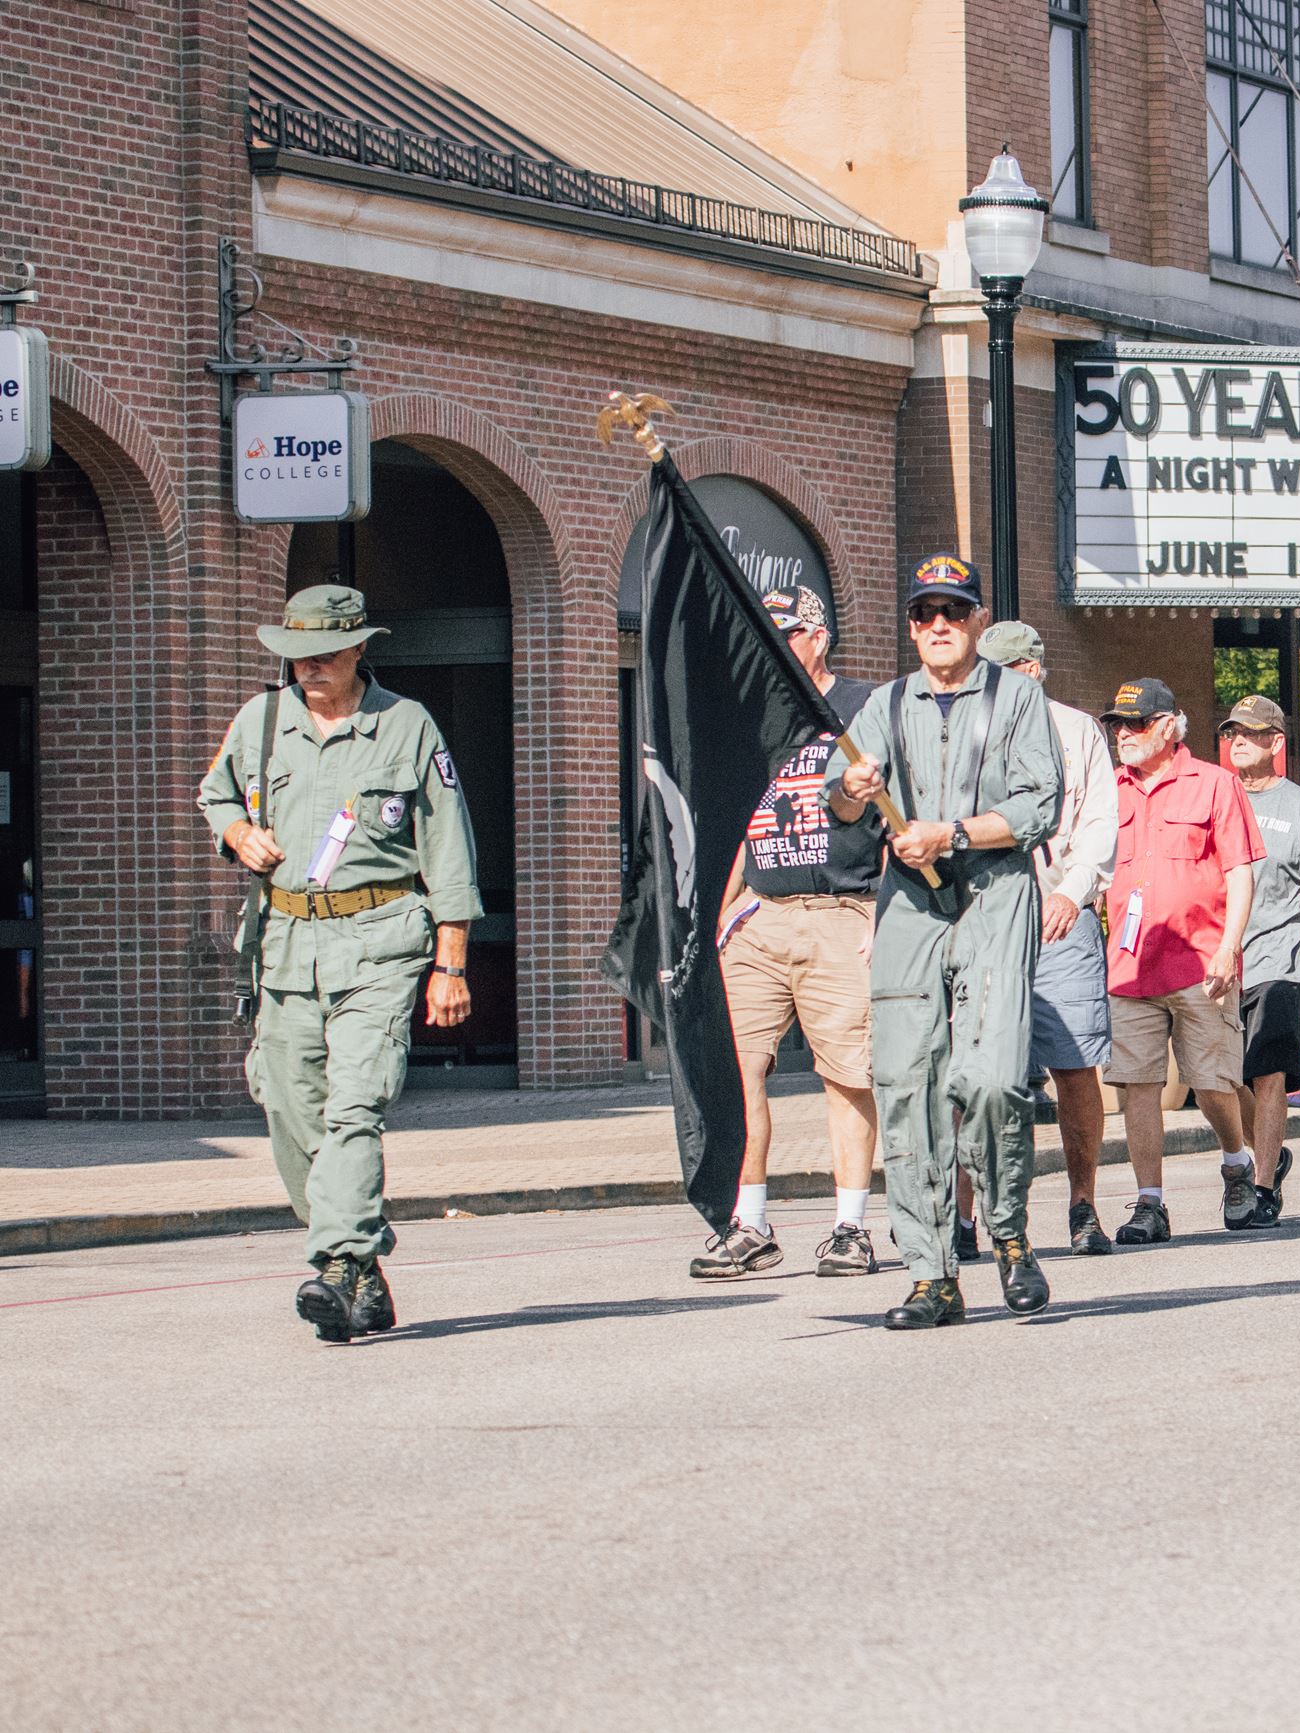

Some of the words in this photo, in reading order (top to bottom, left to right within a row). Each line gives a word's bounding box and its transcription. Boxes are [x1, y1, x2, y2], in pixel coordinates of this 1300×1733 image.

[1074, 365, 1160, 436] 50
[273, 436, 343, 463] Hope
[244, 465, 343, 480] COLLEGE
[1100, 455, 1127, 489] A
[1150, 457, 1256, 492] NIGHT
[1146, 541, 1248, 577] JUNE
[800, 745, 829, 760] FOR
[779, 759, 817, 777] FLAG
[750, 841, 756, 855] I
[755, 837, 796, 854] KNEEL
[799, 833, 829, 850] FOR
[755, 854, 779, 870] THE
[780, 849, 828, 867] CROSS
